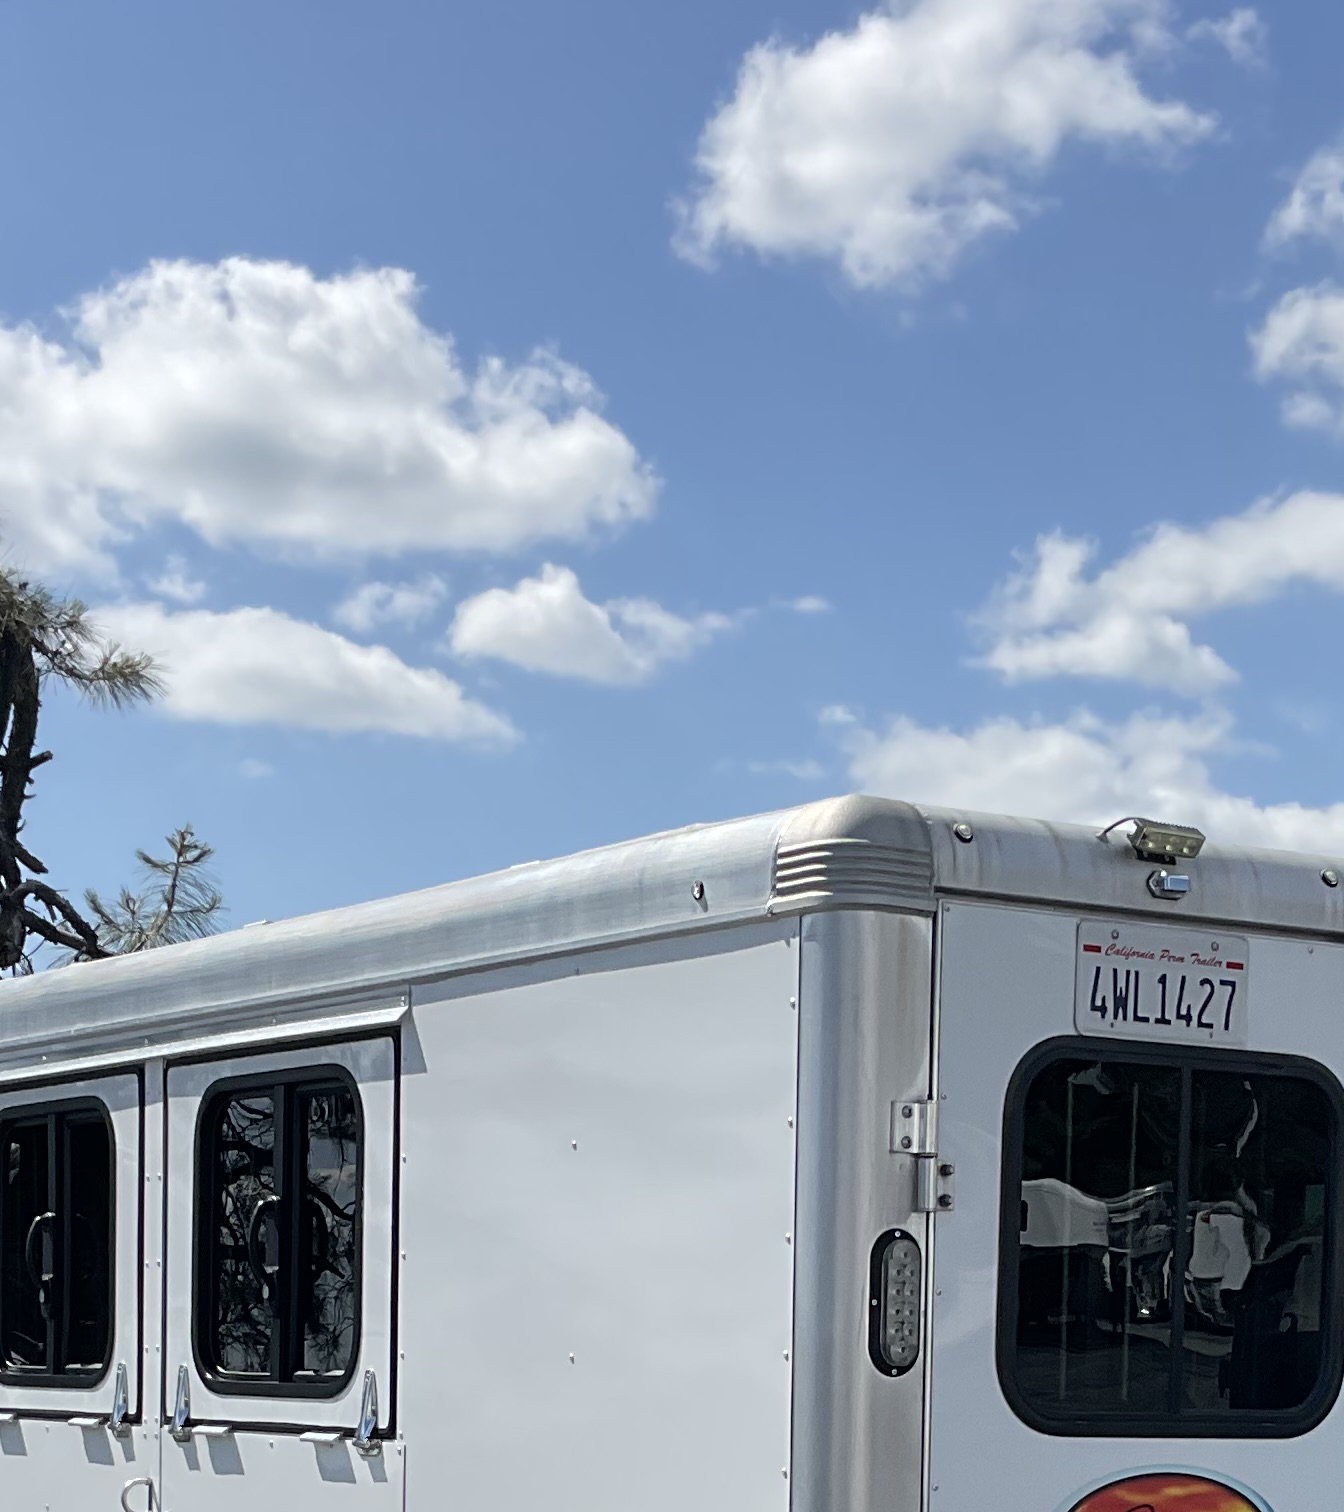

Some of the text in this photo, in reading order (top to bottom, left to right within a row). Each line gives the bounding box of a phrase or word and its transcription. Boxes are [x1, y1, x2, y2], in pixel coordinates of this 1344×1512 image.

[1104, 943, 1223, 968] California Perm Trailer
[1089, 966, 1237, 1032] 4WL1427
